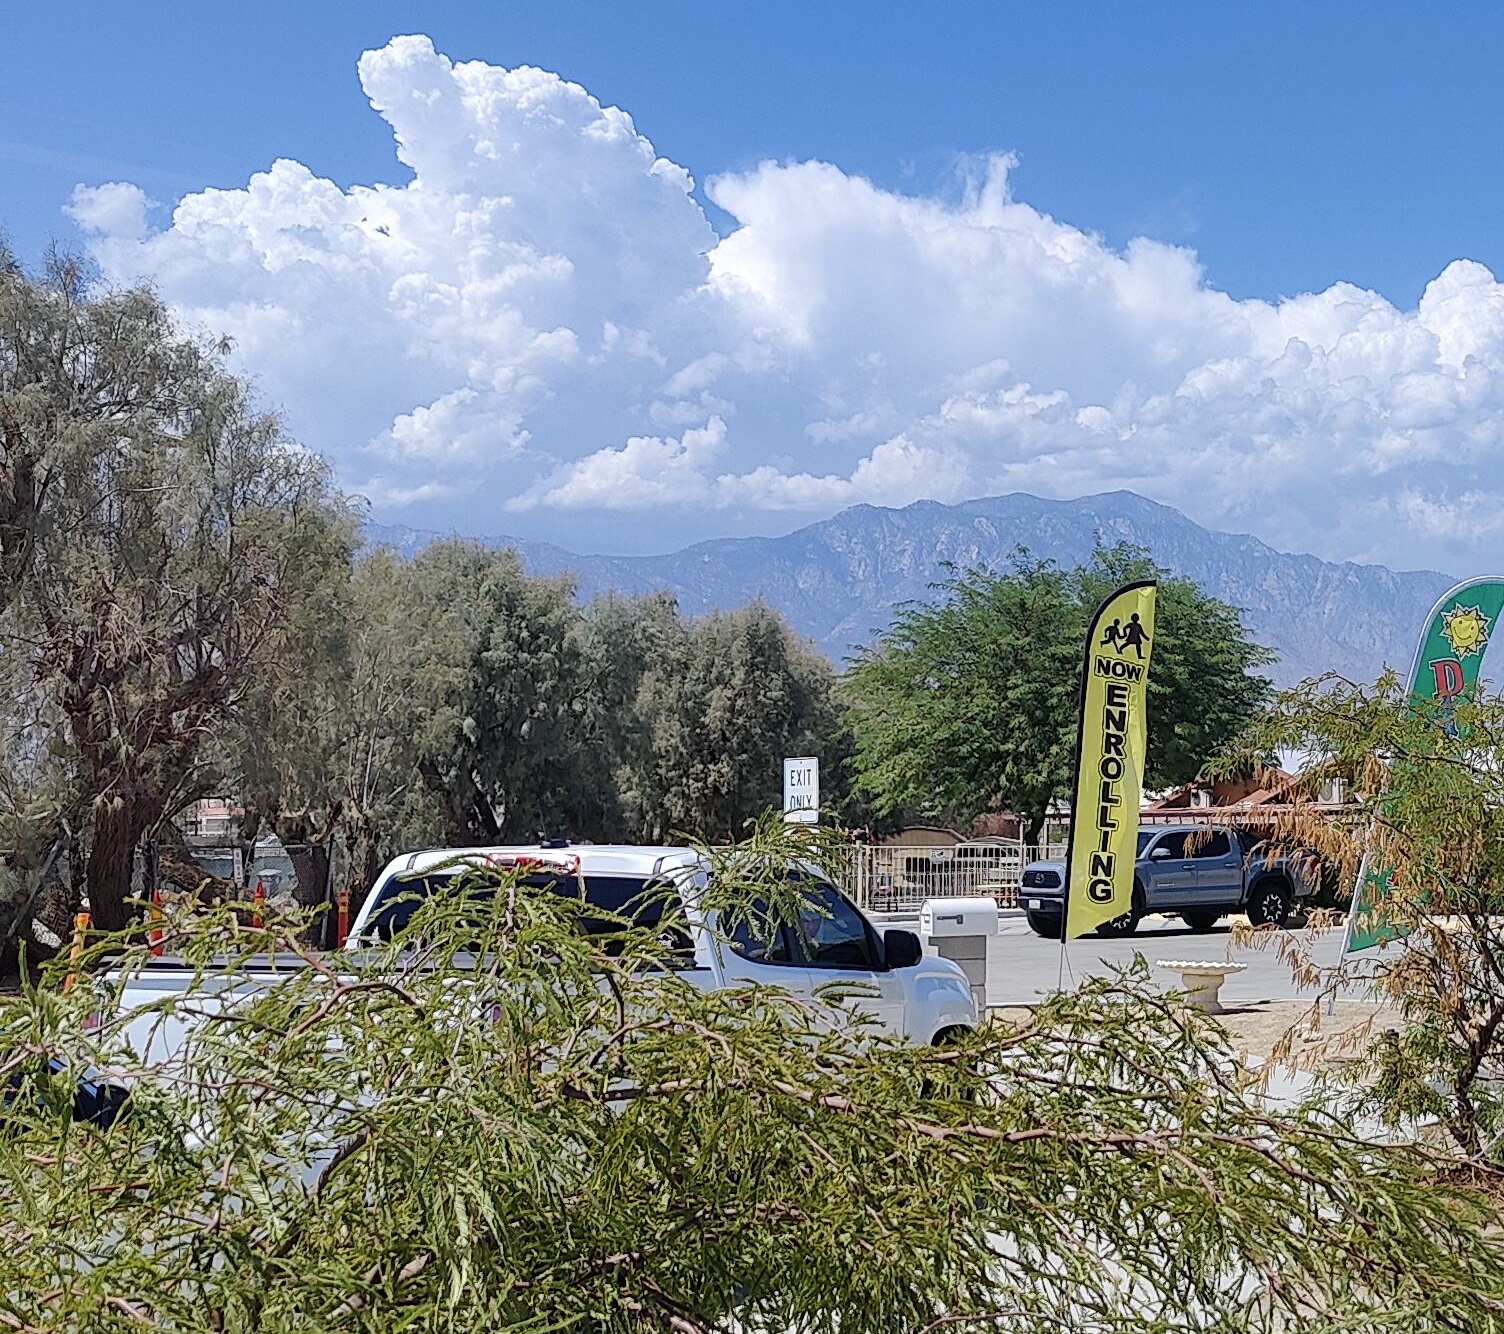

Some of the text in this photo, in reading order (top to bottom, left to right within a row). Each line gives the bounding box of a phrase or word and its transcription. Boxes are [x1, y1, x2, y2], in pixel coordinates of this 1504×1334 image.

[1096, 657, 1144, 683] NOW
[790, 769, 812, 787] EXIT
[789, 794, 812, 810] ONLY
[1088, 683, 1129, 902] ENROLLING
